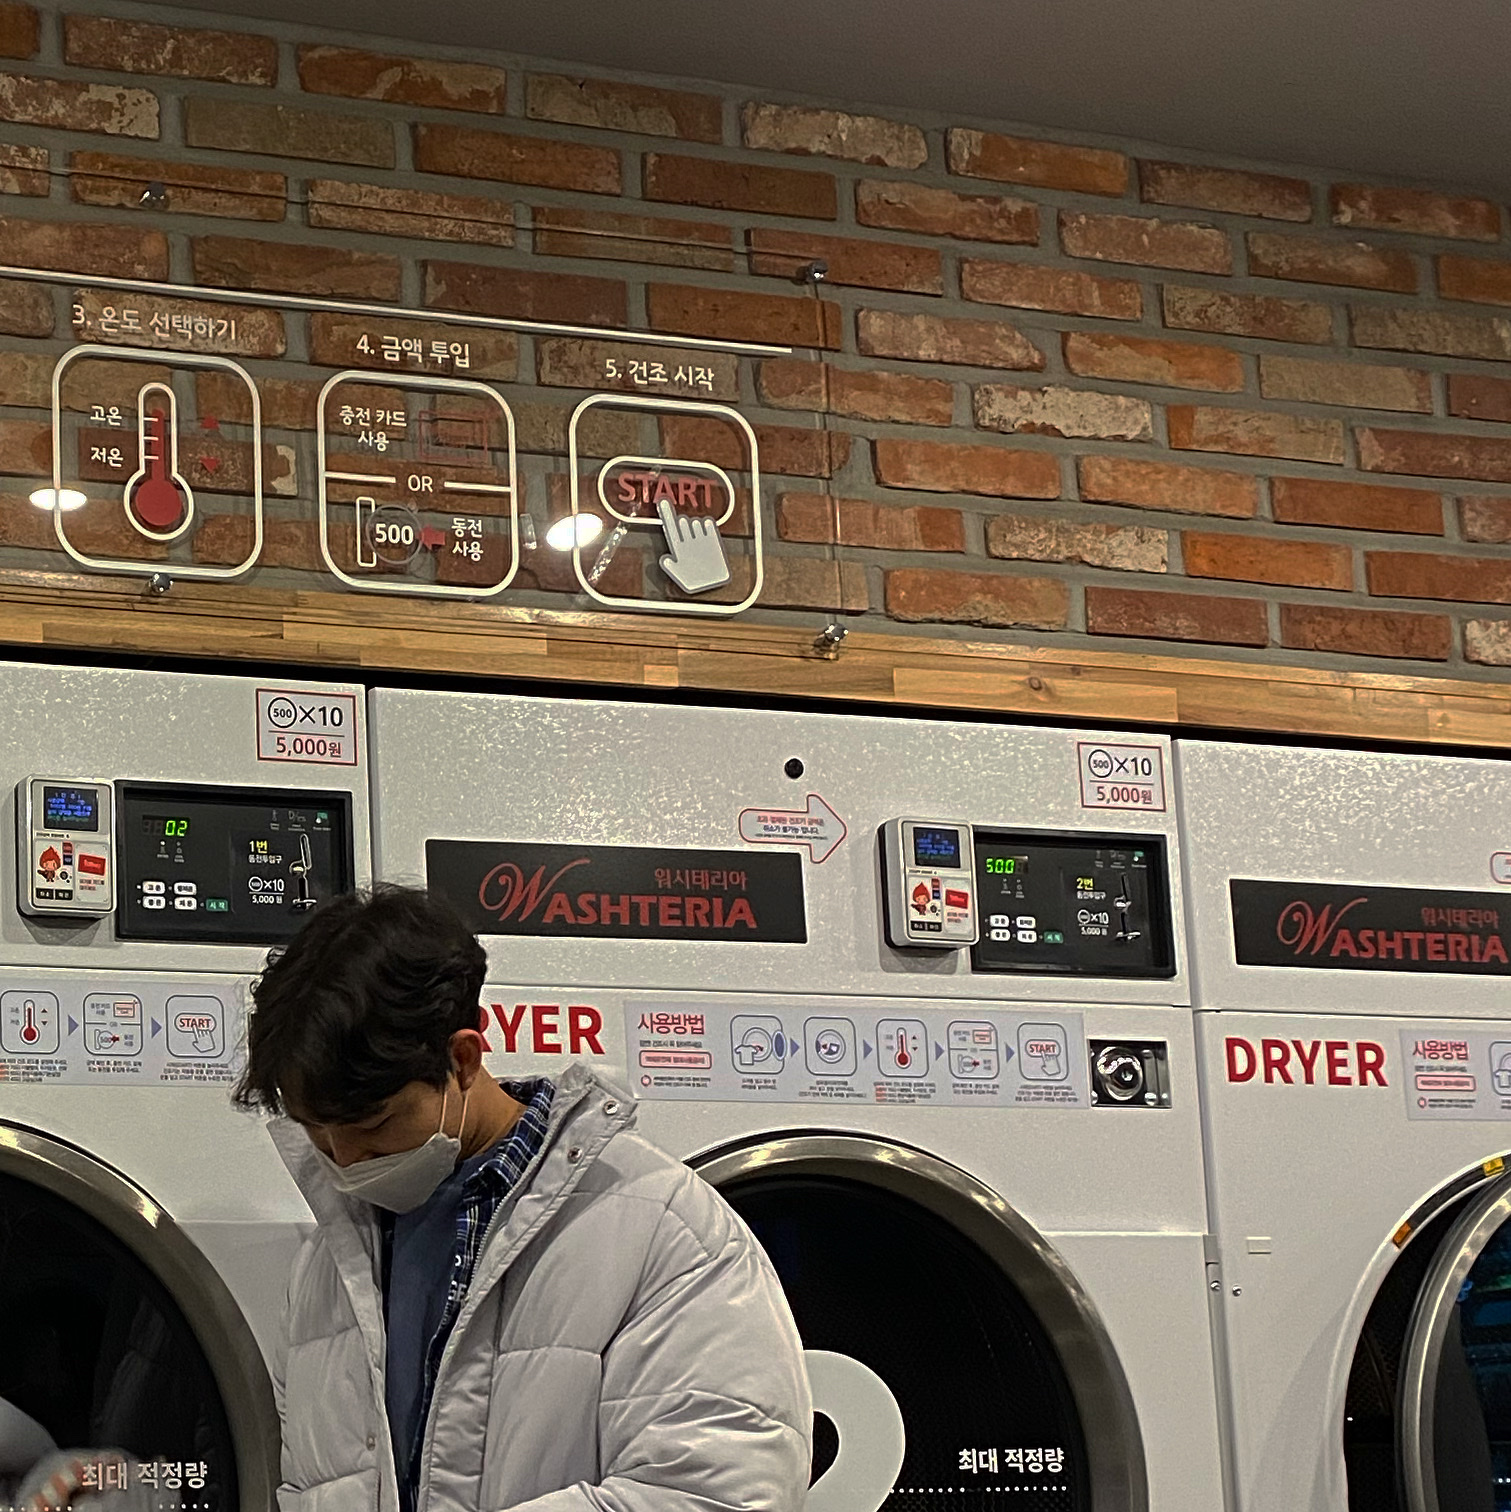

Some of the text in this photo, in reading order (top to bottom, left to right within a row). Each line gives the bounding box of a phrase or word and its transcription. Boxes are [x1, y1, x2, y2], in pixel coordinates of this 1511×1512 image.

[72, 305, 237, 340] 3. 온도 선택하기
[356, 334, 470, 367] 4. 금액 투입
[606, 359, 715, 390] 5. 건조 시작
[90, 405, 122, 426] 고온
[339, 405, 371, 426] 충전
[357, 431, 389, 452] 사용
[90, 446, 124, 467] 저온
[407, 475, 434, 493] OR
[617, 472, 718, 509] START
[374, 522, 414, 545] 500
[451, 517, 484, 538] 동전
[451, 541, 484, 561] 사용
[275, 735, 342, 759] 5,000원
[1096, 786, 1153, 805] 5,000원
[165, 820, 187, 836] 02
[653, 867, 748, 892] 워시테리아
[479, 857, 758, 929] WASHTERIA
[1276, 897, 1509, 964] WASHTERIA
[179, 1017, 212, 1029] START
[478, 1003, 605, 1055] YER
[636, 1011, 706, 1036] 사용방법
[1029, 1044, 1056, 1055] START
[1412, 1040, 1470, 1062] 사용방법
[1225, 1037, 1389, 1087] DRYER
[958, 1447, 1065, 1474] 최대 적정량
[81, 1460, 208, 1491] 최대 적정량
